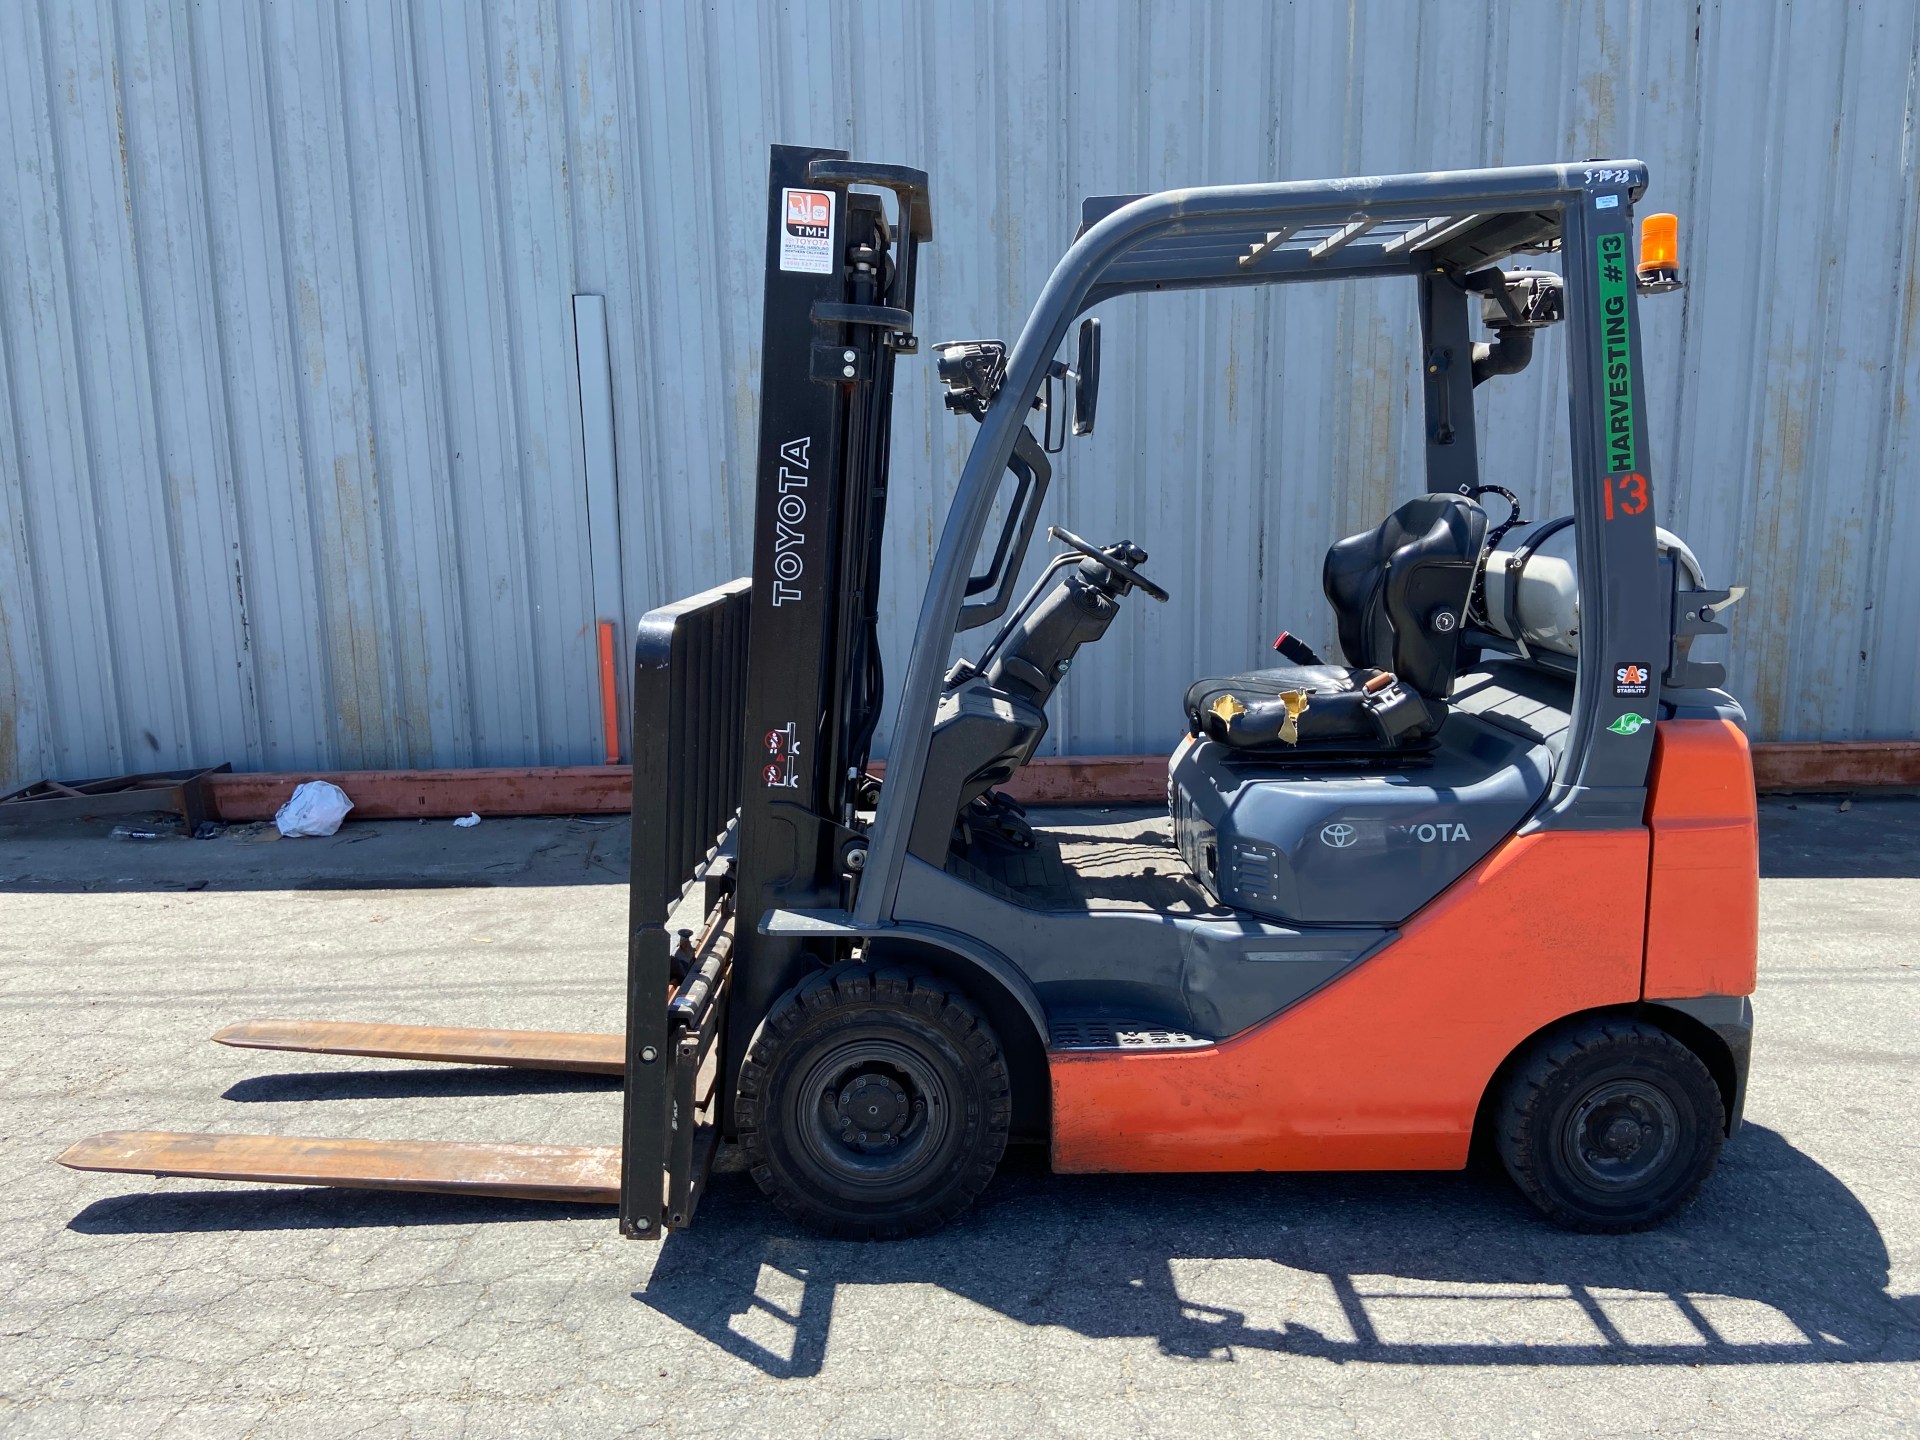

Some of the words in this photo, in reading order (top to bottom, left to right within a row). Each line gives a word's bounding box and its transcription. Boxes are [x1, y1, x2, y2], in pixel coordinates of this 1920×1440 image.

[796, 226, 827, 238] TMH
[796, 238, 829, 246] TOYOTA
[1602, 235, 1623, 283] #13
[1605, 296, 1632, 472] HARVESTING
[1603, 473, 1649, 521] 13
[772, 436, 811, 607] TOYOTA
[1616, 666, 1648, 684] SAS
